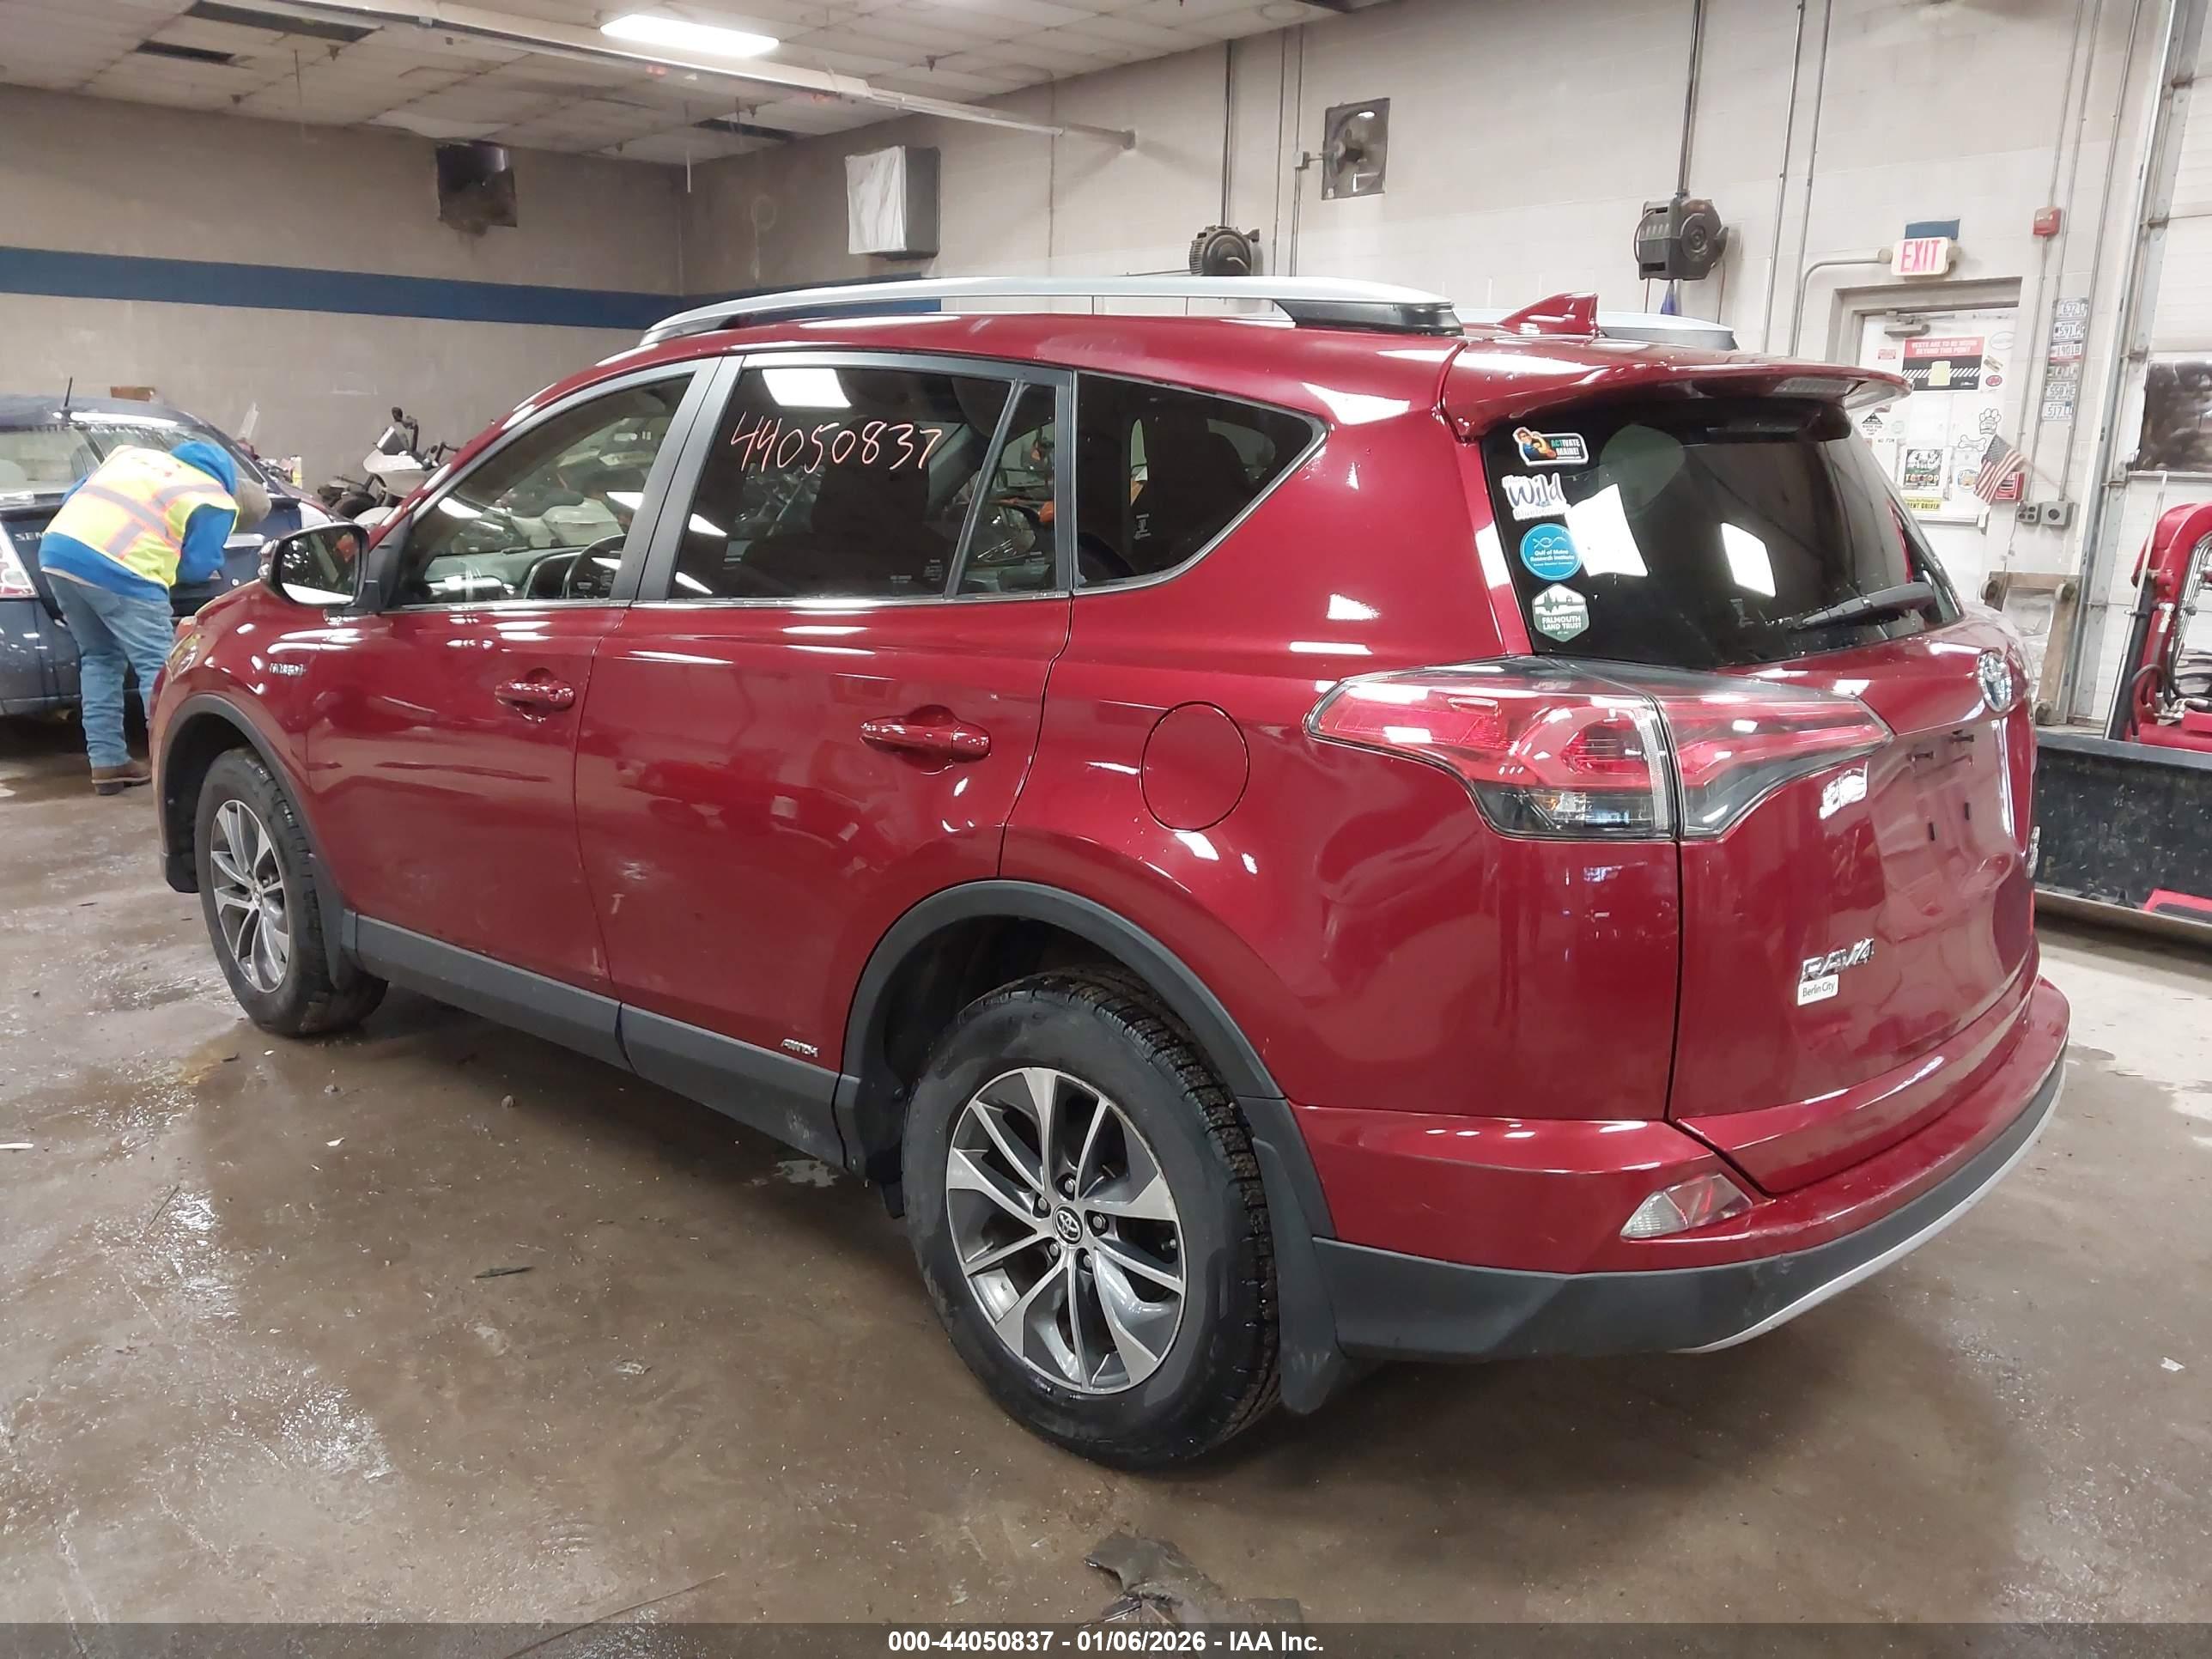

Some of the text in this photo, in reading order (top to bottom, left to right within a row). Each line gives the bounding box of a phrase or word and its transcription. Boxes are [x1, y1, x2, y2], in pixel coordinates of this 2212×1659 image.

[1900, 240, 1941, 272] EXIT
[730, 410, 943, 474] 44050837
[1551, 438, 1581, 447] ACTIVATE
[1509, 474, 1563, 507] Wild
[1530, 555, 1553, 563] Research
[1541, 615, 1581, 624] FALMOUTH
[1801, 937, 1875, 984] RAV4
[1802, 981, 1836, 997] Berlin City
